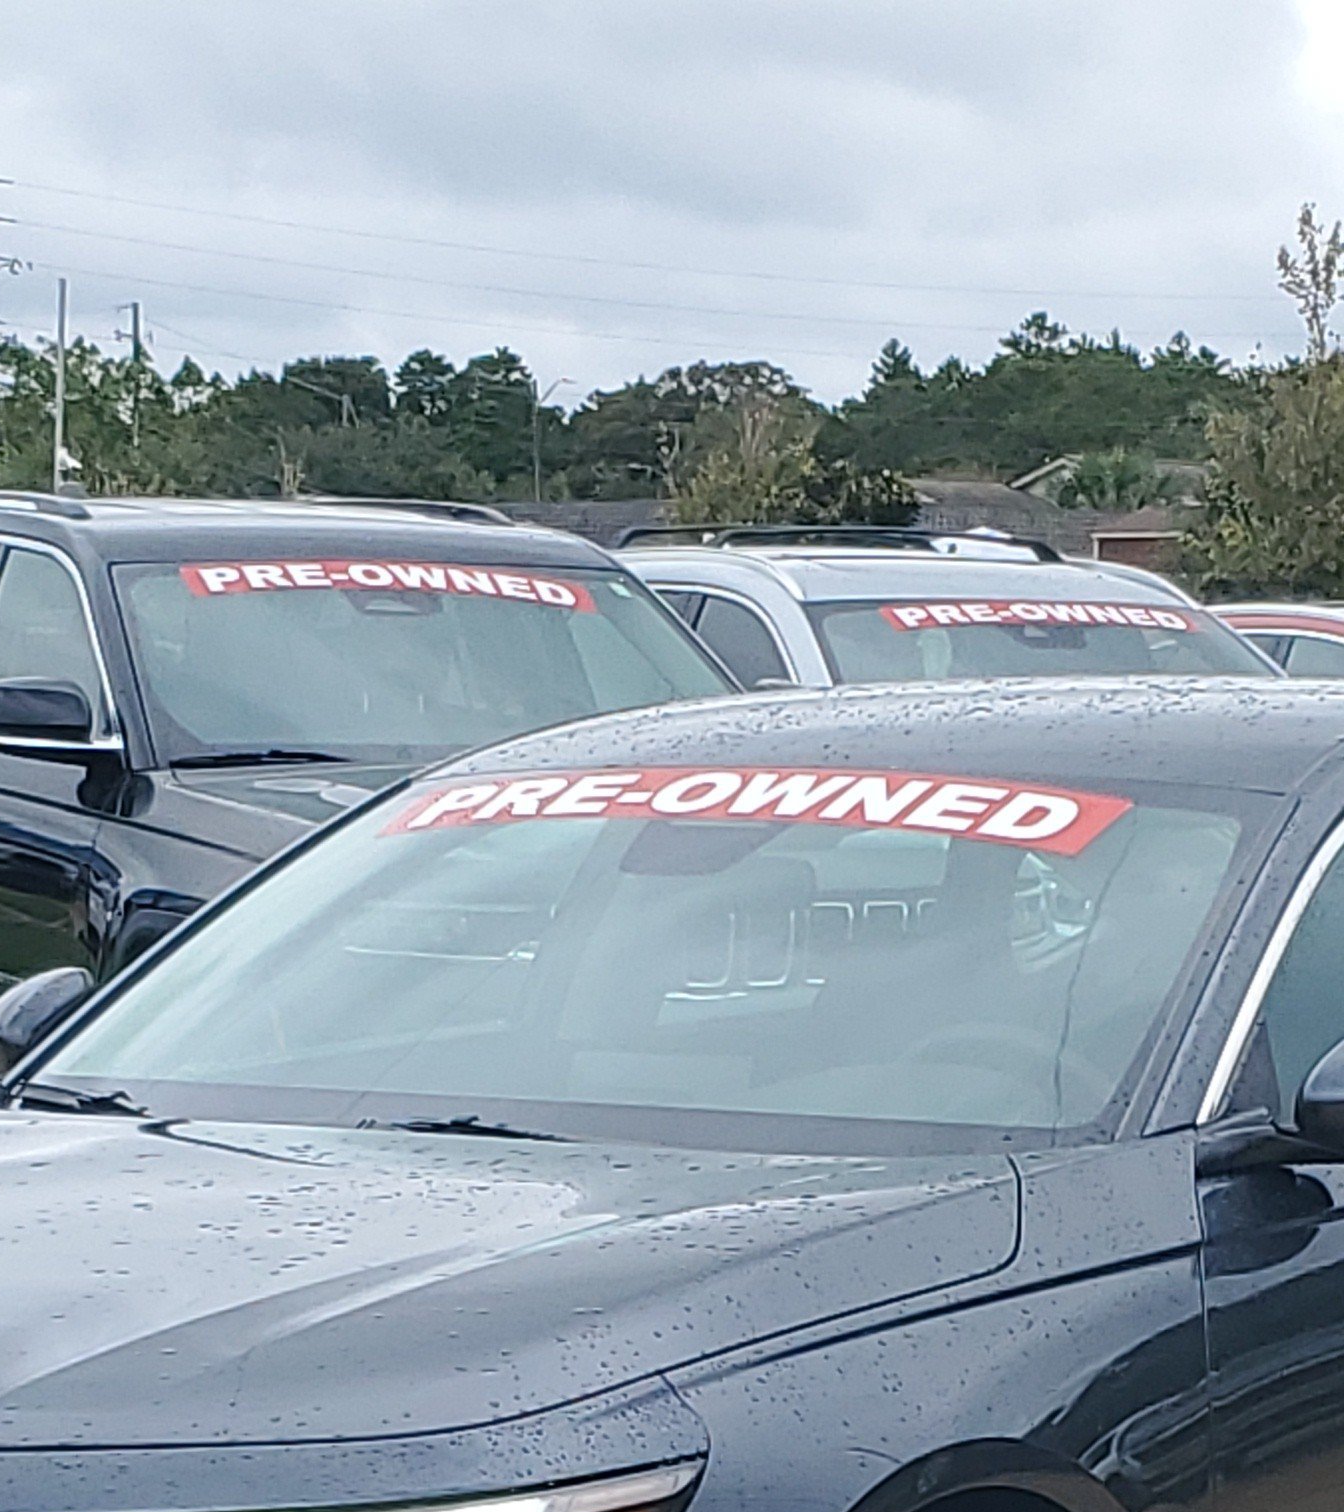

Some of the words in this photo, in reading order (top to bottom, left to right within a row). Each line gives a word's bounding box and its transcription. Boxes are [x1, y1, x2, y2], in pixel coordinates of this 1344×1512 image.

[197, 563, 577, 606] PRE-OWNED
[893, 603, 1187, 631] PRE-OWNED
[406, 772, 1079, 840] PRE-OWNED
